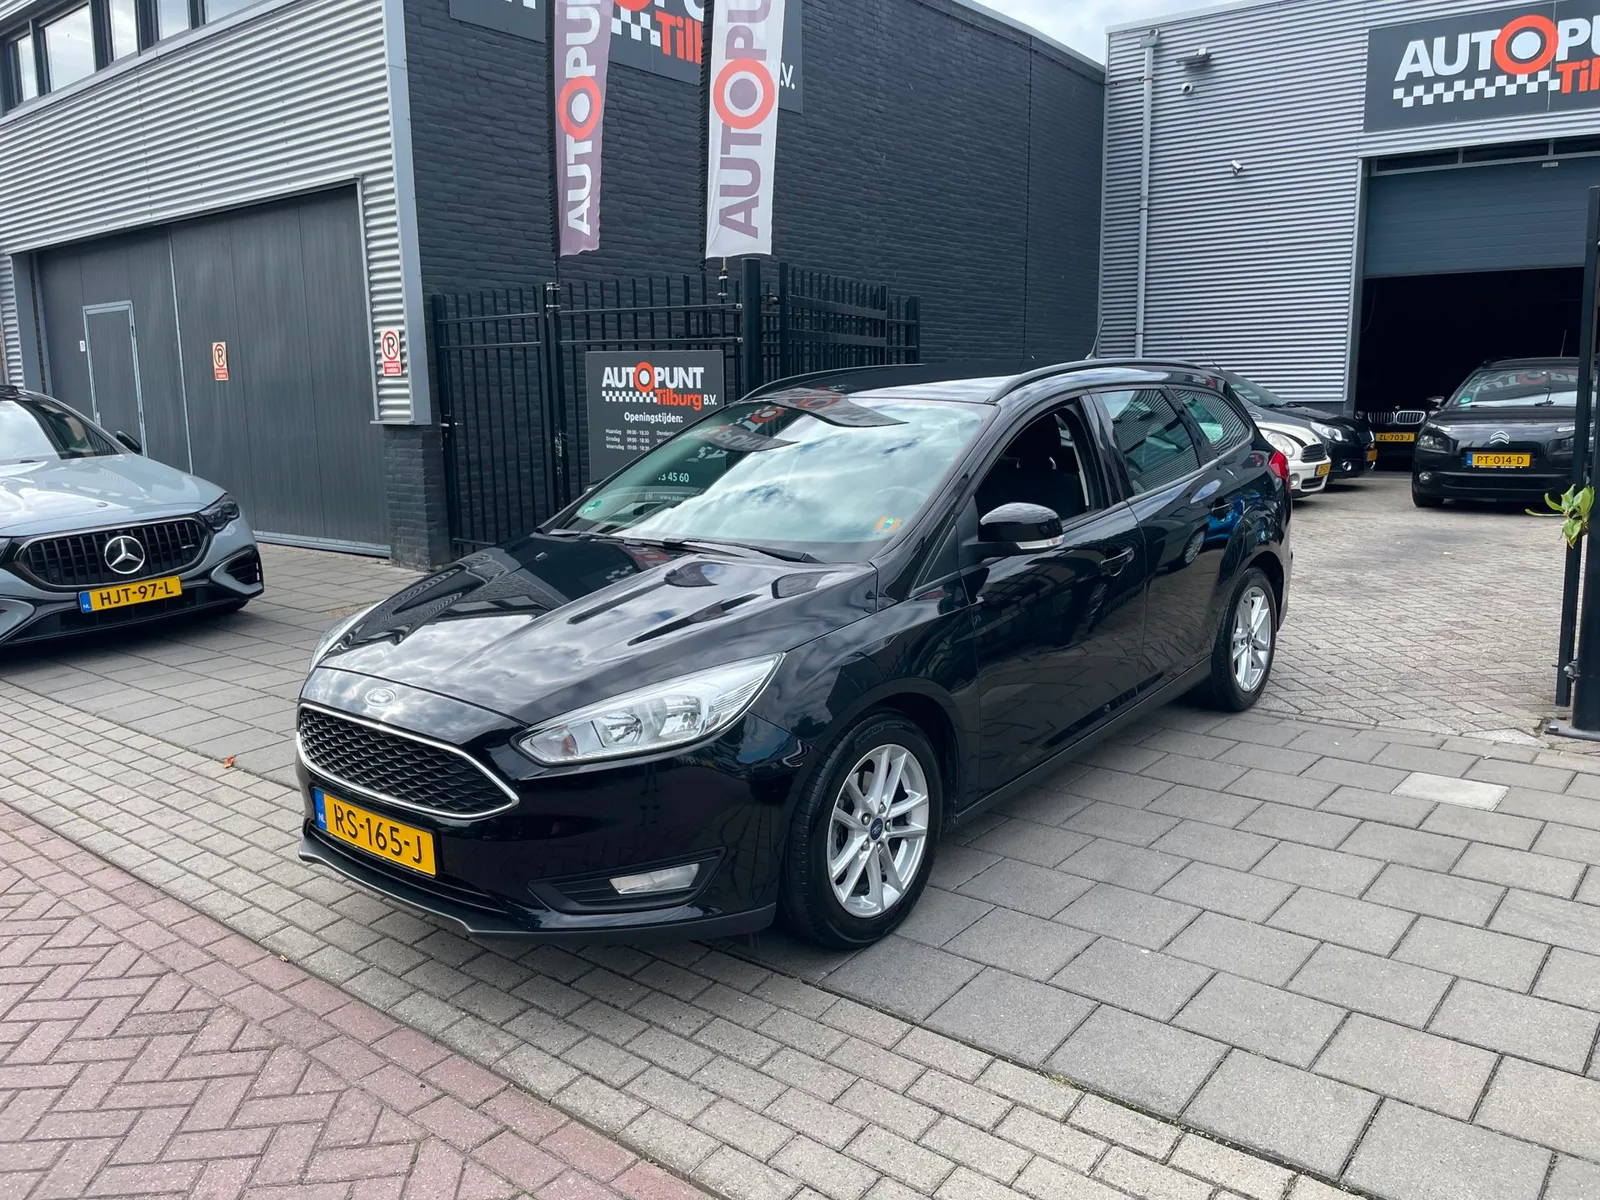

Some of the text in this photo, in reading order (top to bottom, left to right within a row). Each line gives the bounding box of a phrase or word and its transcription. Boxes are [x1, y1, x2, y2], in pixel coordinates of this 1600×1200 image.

[1394, 14, 1600, 81] AUTOP
[558, 0, 602, 236] AUTOPU
[602, 361, 704, 393] AUTOPUNT
[654, 388, 717, 411] Tilburg B.V.
[624, 411, 683, 425] Openingstijden:
[1476, 455, 1524, 465] PT-014-D
[667, 471, 678, 482] 45
[679, 472, 690, 483] 60
[101, 583, 174, 606] HJT-97-L
[333, 803, 423, 865] RS-165-J
